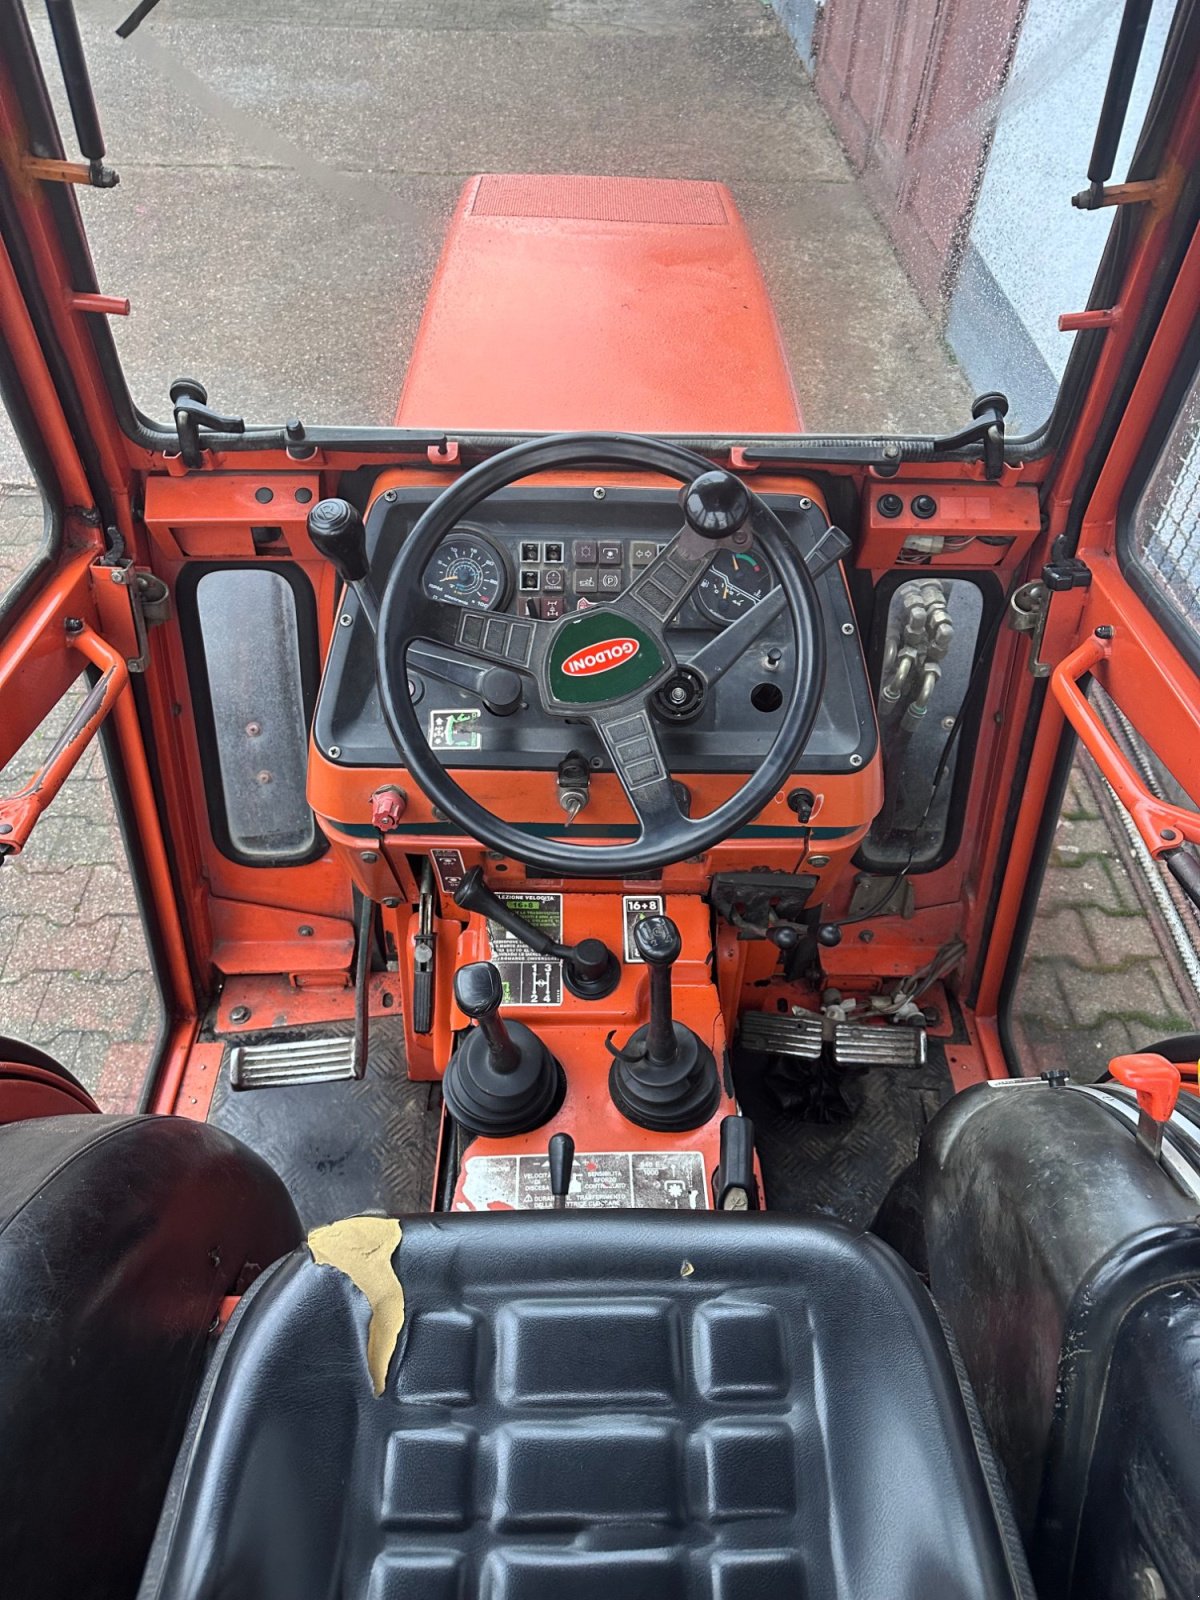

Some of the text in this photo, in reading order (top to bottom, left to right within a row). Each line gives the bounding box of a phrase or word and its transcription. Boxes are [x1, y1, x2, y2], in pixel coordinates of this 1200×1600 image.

[568, 642, 634, 672] GOLDONI
[628, 901, 657, 910] 16+8
[531, 964, 552, 972] 1 3
[530, 995, 538, 1003] 2
[543, 995, 551, 1003] 4
